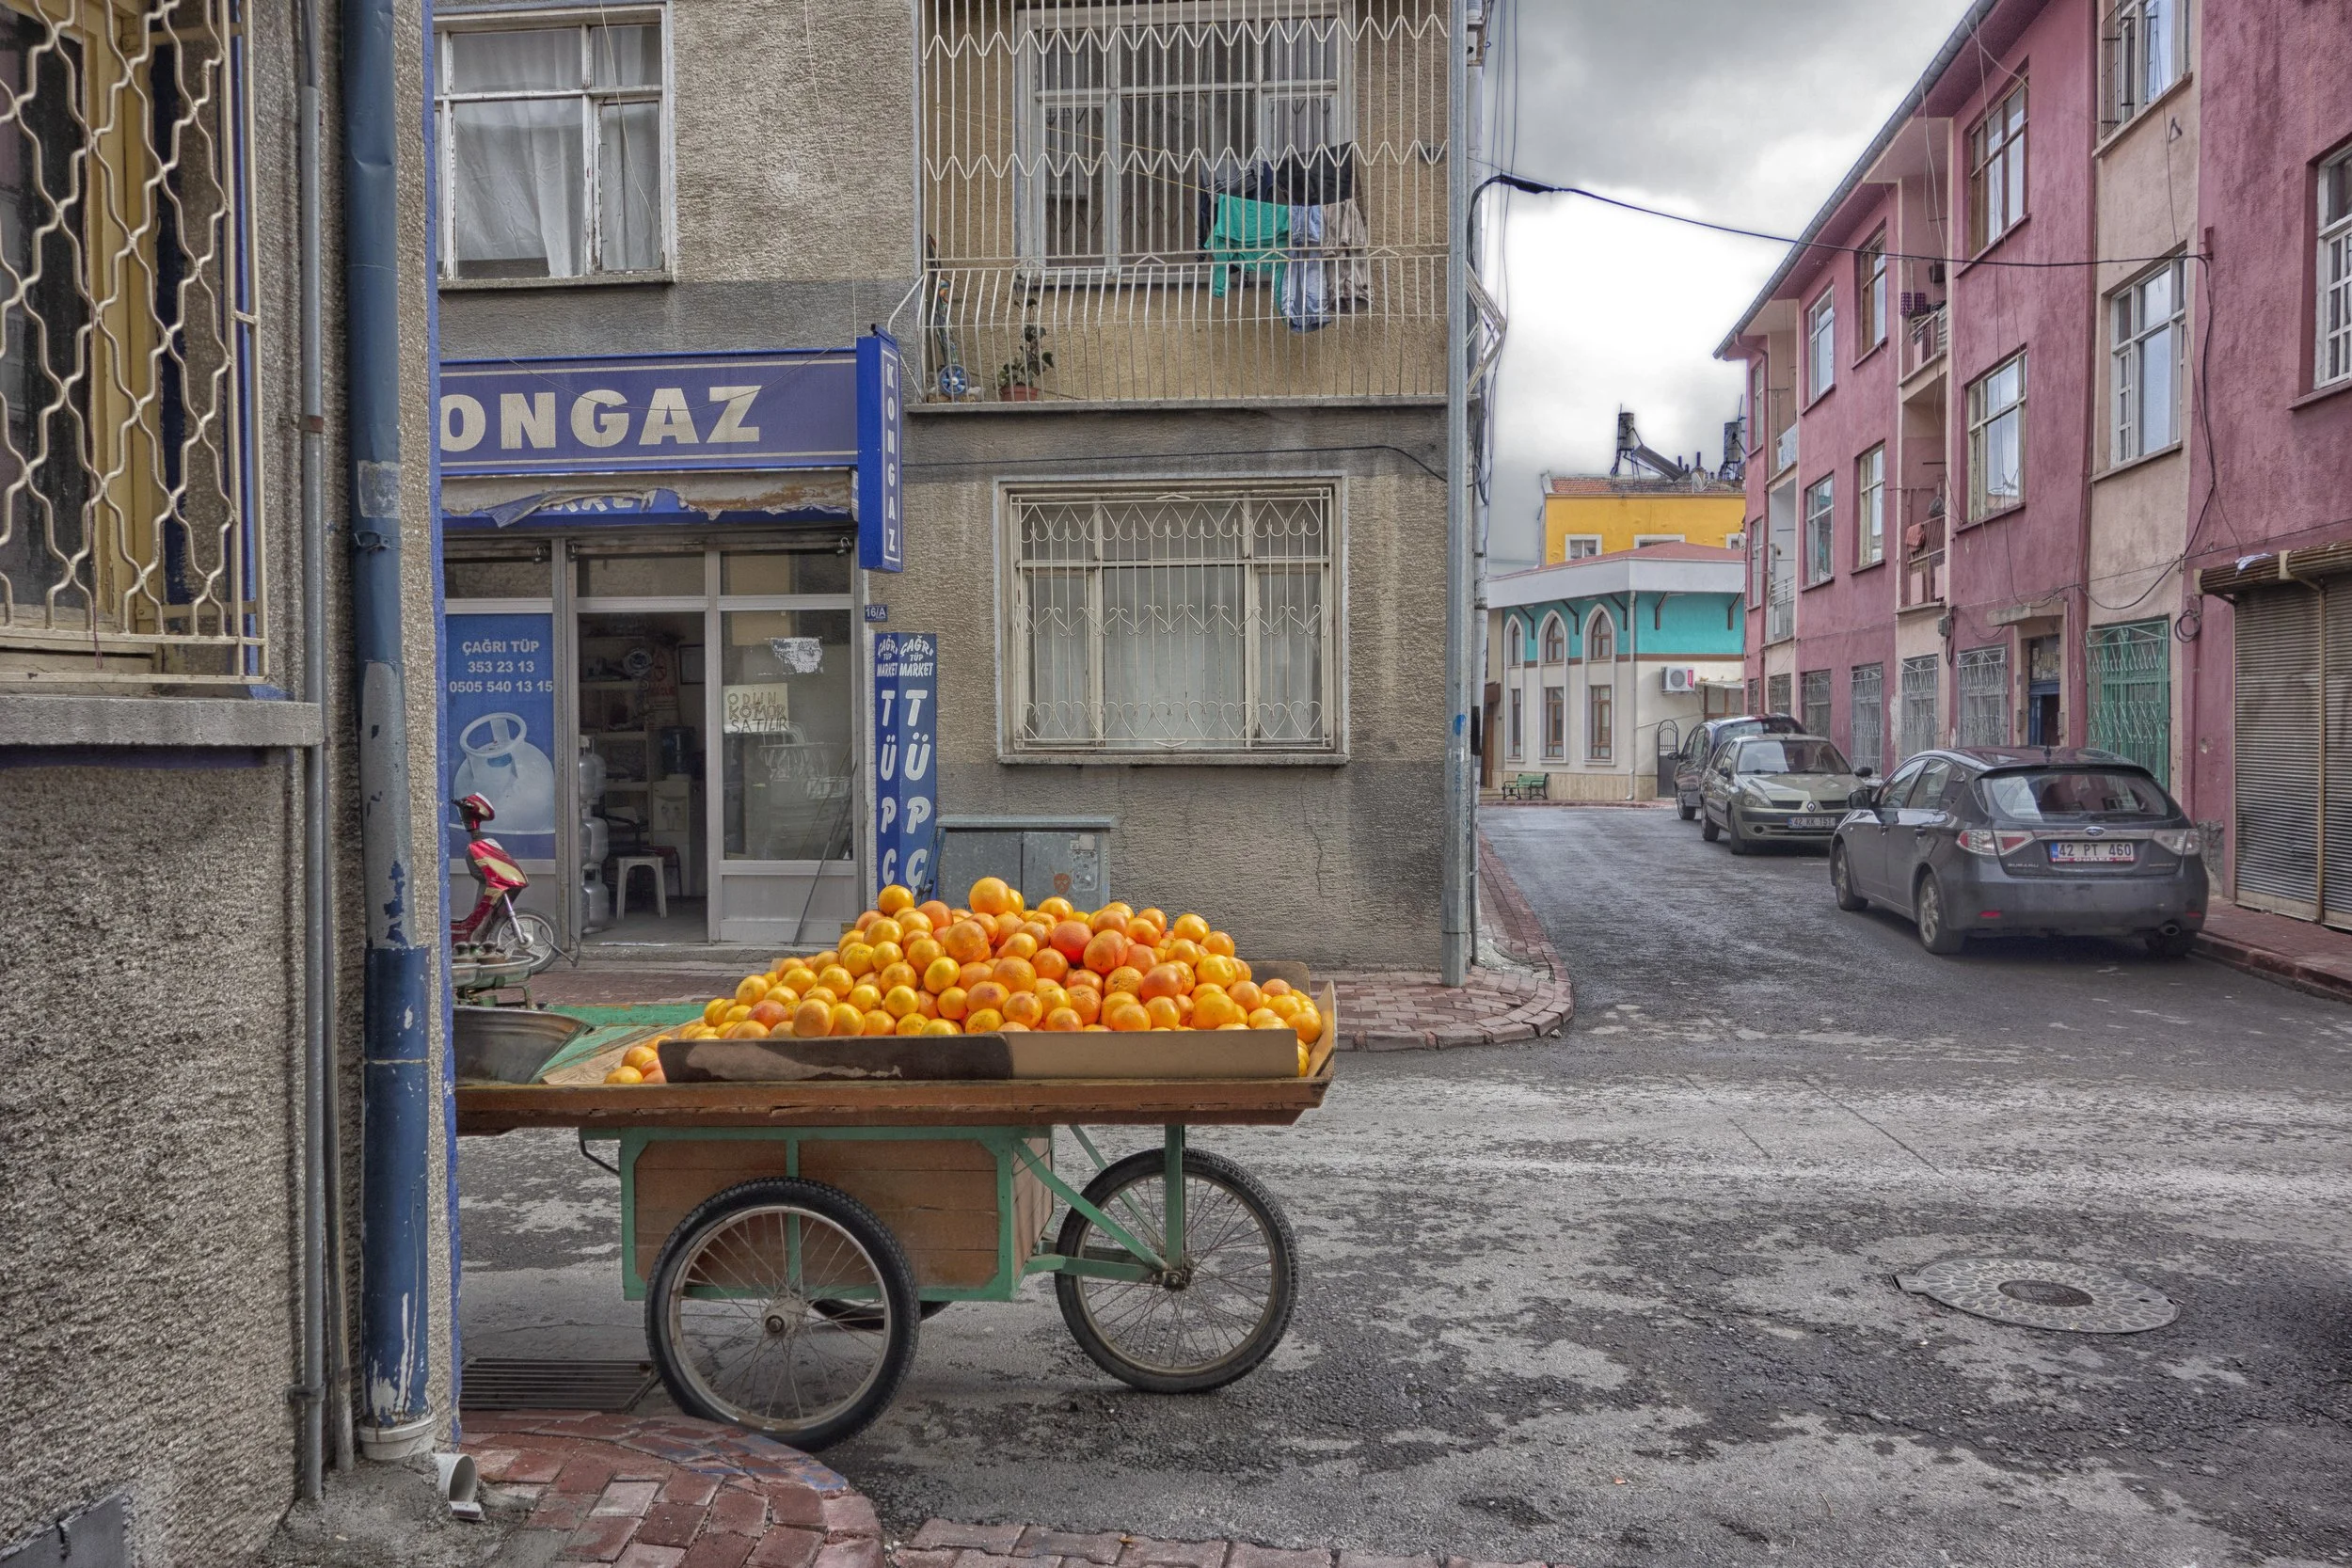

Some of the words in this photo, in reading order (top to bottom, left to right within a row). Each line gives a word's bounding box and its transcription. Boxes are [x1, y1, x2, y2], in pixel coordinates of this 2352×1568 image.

[886, 363, 896, 552] KONGAZ
[865, 607, 886, 618] 16/A
[462, 639, 507, 657] ÇAĞRI
[511, 639, 539, 653] TÜP
[910, 652, 924, 662] TÜP
[468, 661, 493, 673] 353
[497, 661, 514, 673] 23
[518, 661, 535, 673] 13
[876, 662, 898, 677] MARKET
[899, 662, 934, 677] MARKET
[450, 681, 483, 693] 0505
[486, 681, 512, 693] 540
[516, 681, 532, 693] 13
[537, 681, 553, 692] 15
[727, 692, 777, 705] ODUN
[2058, 844, 2074, 856] 42
[2083, 844, 2099, 856] PT
[2108, 844, 2132, 856] 460
